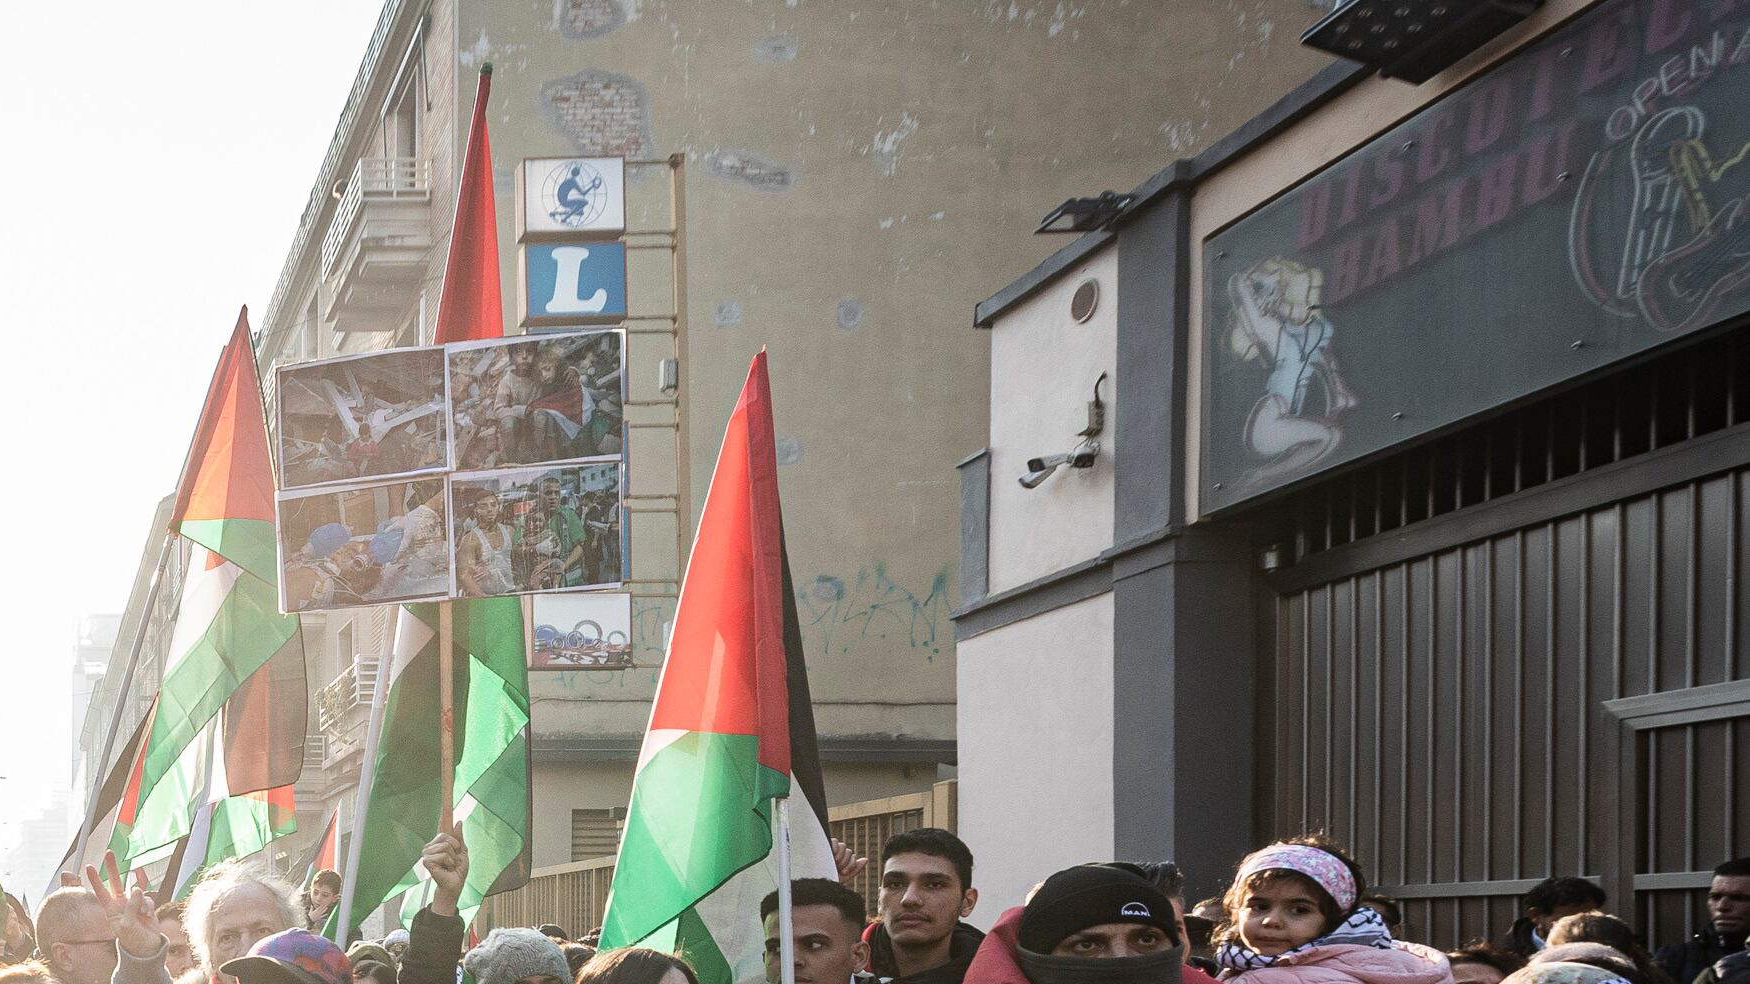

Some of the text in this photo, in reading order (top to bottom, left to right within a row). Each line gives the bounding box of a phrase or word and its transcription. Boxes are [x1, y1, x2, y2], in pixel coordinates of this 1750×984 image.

[1298, 0, 1740, 251] DISCOTEC
[1605, 30, 1725, 141] OPEN
[545, 246, 608, 314] L
